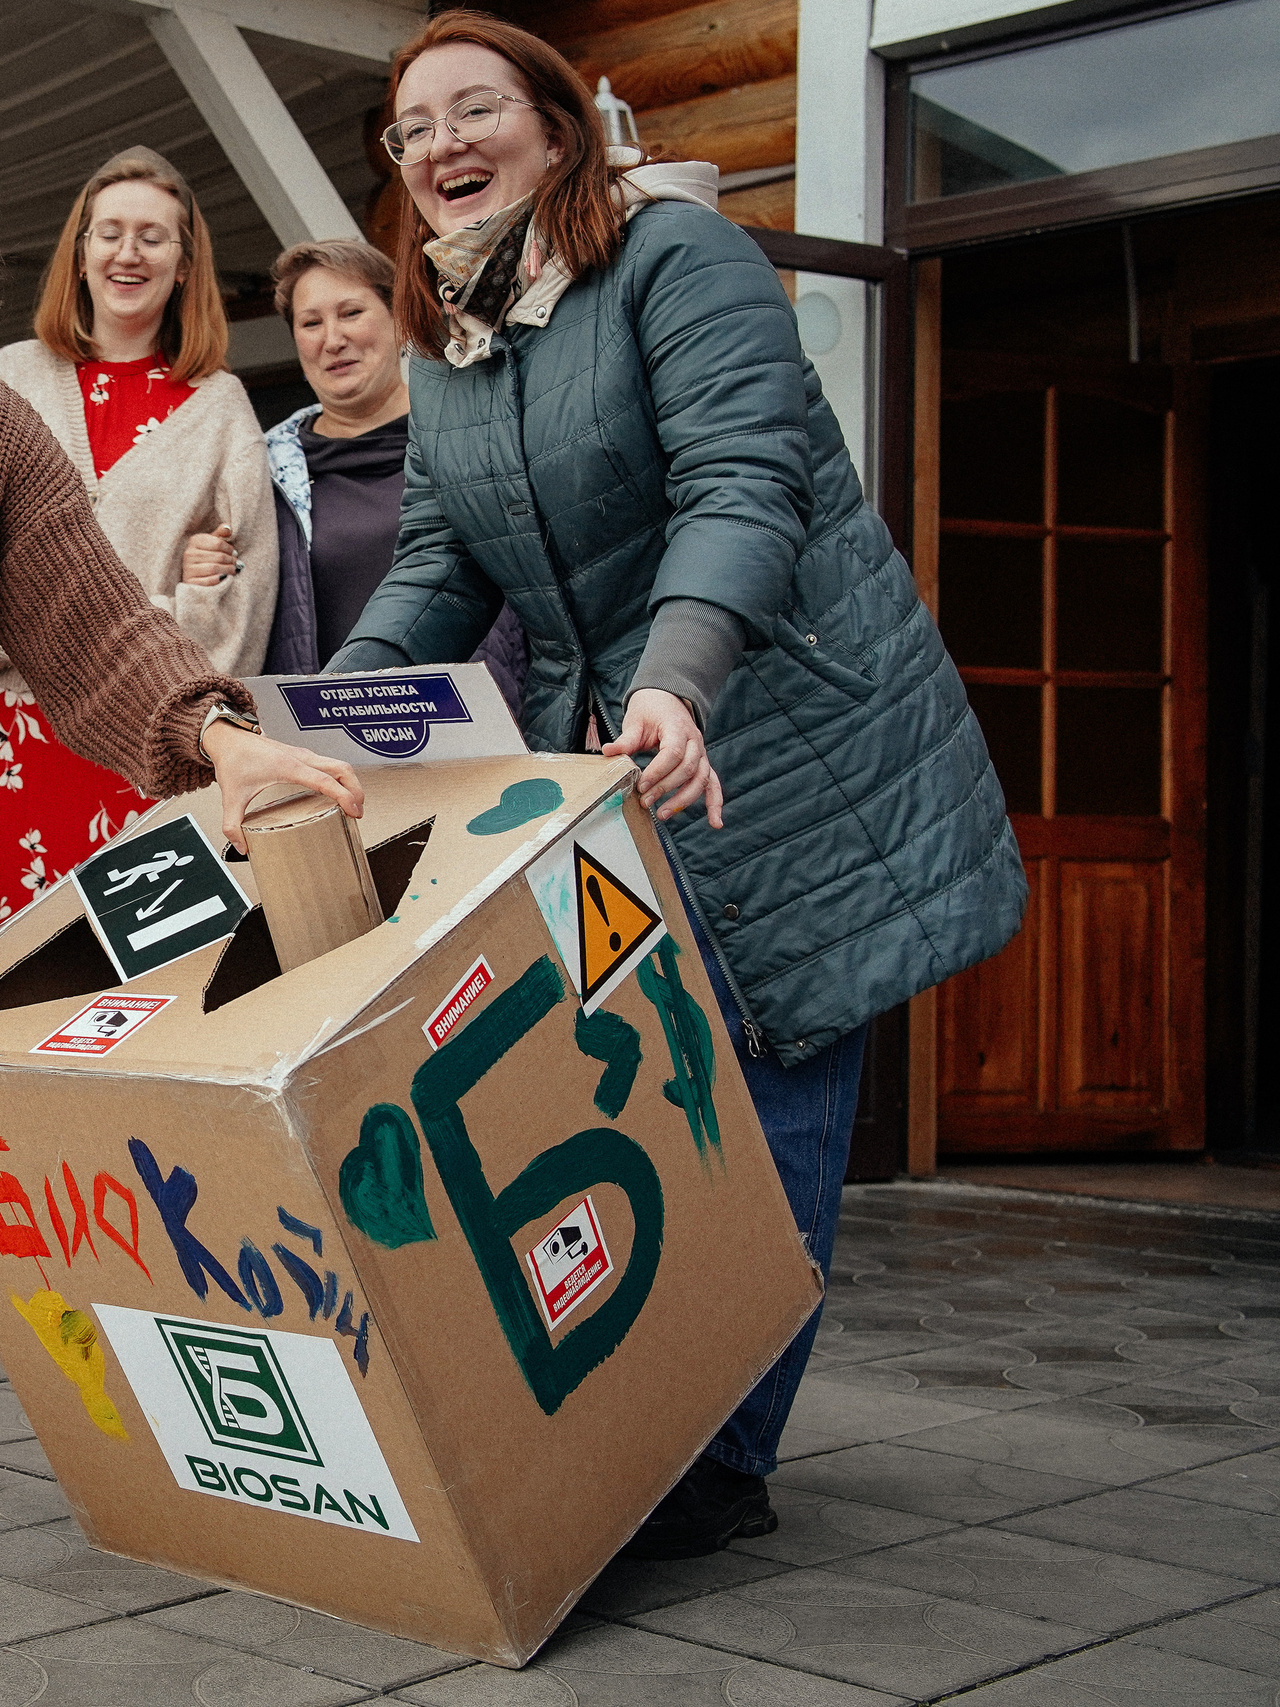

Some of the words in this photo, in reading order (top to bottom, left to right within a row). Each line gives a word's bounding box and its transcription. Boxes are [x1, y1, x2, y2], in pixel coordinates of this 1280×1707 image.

[320, 686, 365, 702] ОТДЕЛ
[363, 684, 419, 699] УСПЕХА
[318, 707, 331, 719] И
[331, 701, 438, 718] СТАБИЛЬНОСТИ
[361, 726, 417, 743] БИОСАН
[96, 998, 162, 1010] ВНИМАНИЕ!
[433, 972, 487, 1040] ВНИМАНИЕ!
[552, 1258, 604, 1313] ВИДЕОНАБЛЮДЕНИЕ!
[563, 1263, 586, 1290] ВЕДЕТСЯ
[184, 1453, 390, 1531] BIOSAN
